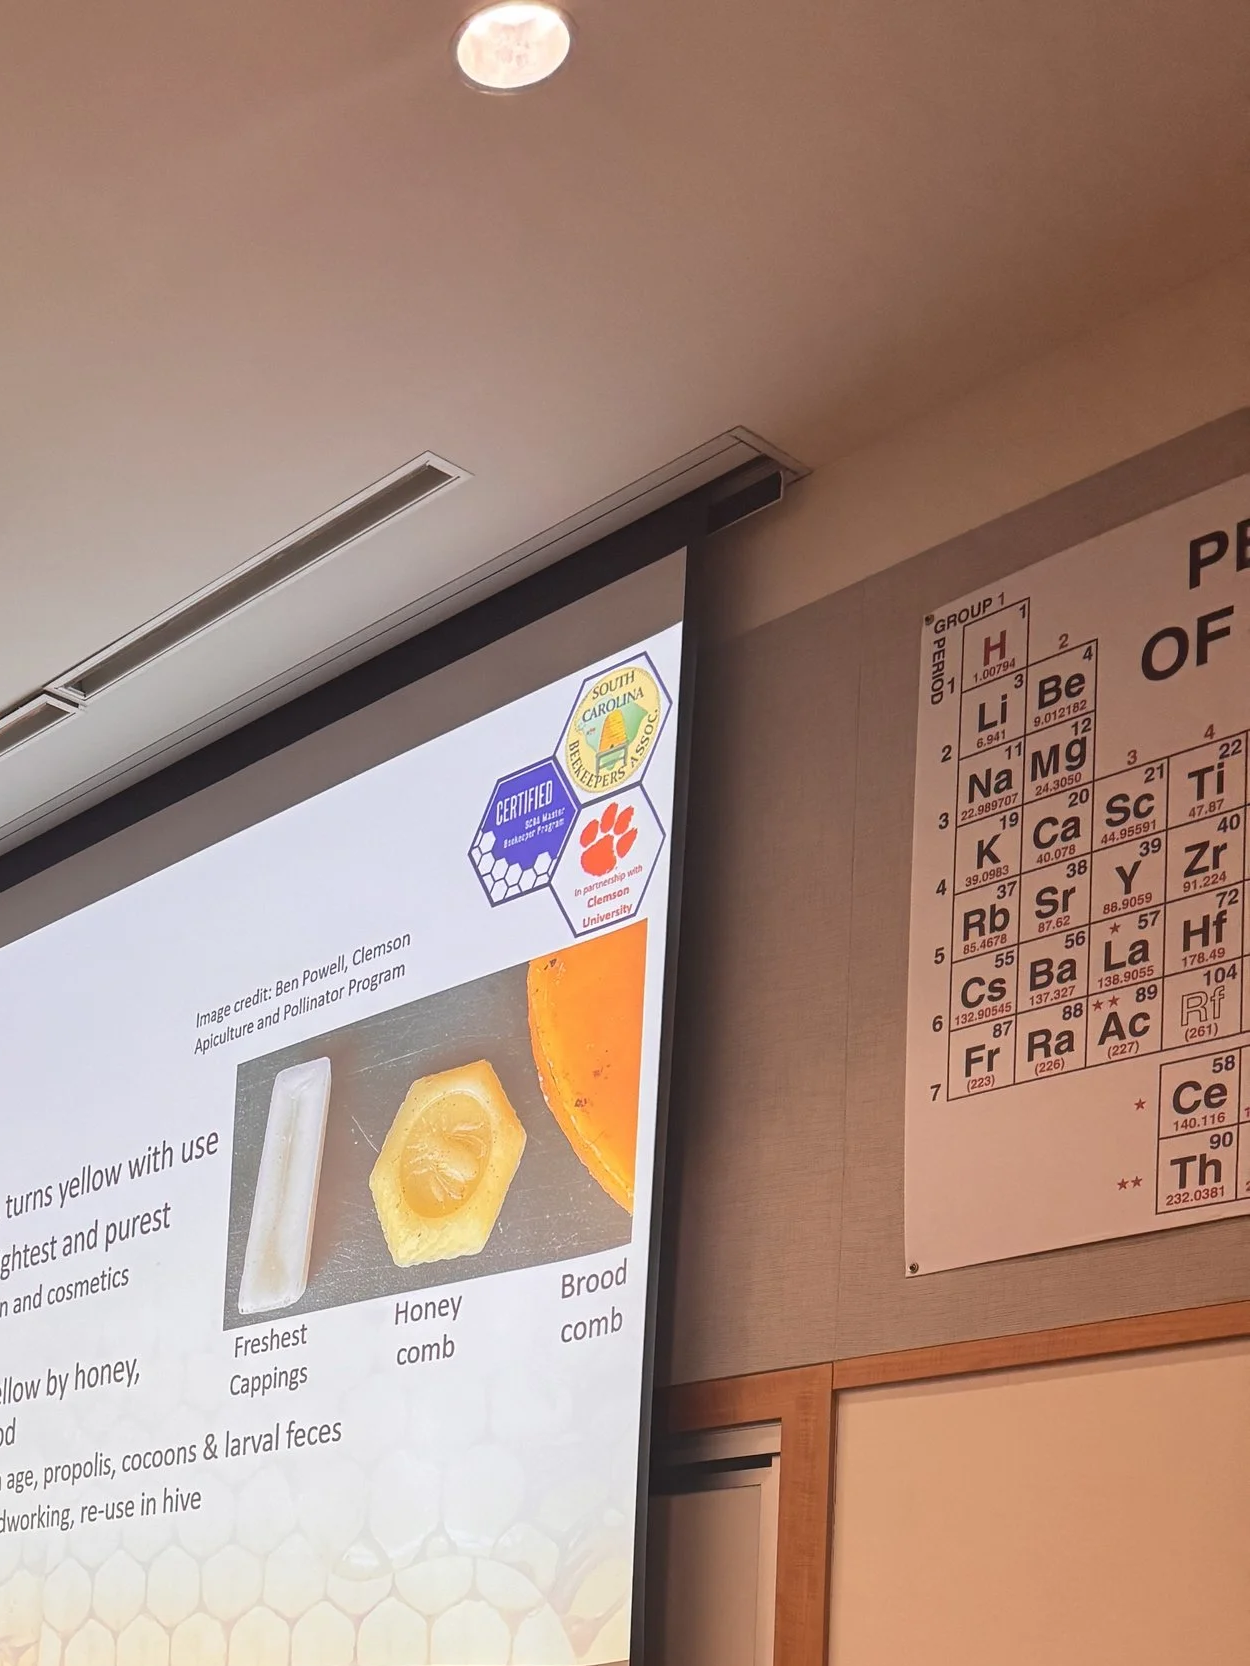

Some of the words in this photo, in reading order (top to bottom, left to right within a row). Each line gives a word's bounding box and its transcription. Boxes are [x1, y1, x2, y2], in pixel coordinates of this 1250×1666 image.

[934, 597, 993, 634] GROUP
[983, 630, 1006, 666] H
[1141, 605, 1234, 681] OF
[592, 670, 635, 700] SOUTH
[931, 636, 945, 705] PERIOD
[973, 658, 1016, 683] 1.00794
[582, 686, 644, 723] CAROLINA
[1038, 672, 1085, 710] Be
[978, 694, 1007, 732] Li
[1034, 700, 1087, 727] 9.012182
[1071, 717, 1092, 736] 12
[568, 740, 626, 789] BEEKEEPERS
[630, 708, 658, 768] ASSOC.
[1031, 736, 1086, 782] Mg
[968, 768, 1013, 804] Na
[1188, 763, 1224, 801] Ti
[496, 780, 553, 826] CERTIFIED
[1106, 792, 1155, 827] Sc
[1032, 815, 1081, 849] Ca
[1101, 819, 1157, 845] 44.95591
[977, 835, 1001, 869] K
[1036, 844, 1076, 864] 40.078
[1184, 841, 1228, 878] Zr
[583, 871, 626, 896] partnership
[627, 864, 642, 880] with
[1115, 861, 1142, 895] Y
[582, 902, 632, 928] University
[587, 886, 630, 909] Clemson
[1034, 884, 1076, 919] Sr
[963, 904, 1010, 941] Rb
[1182, 909, 1228, 952] Hf
[1103, 938, 1150, 972] La
[1182, 947, 1226, 968] 178.49
[196, 1005, 231, 1028] Image
[234, 988, 272, 1013] credit:
[276, 978, 299, 997] Ben
[302, 954, 348, 986] Powell,
[352, 934, 410, 966] Clemson
[1029, 957, 1078, 991] Ba
[1097, 965, 1155, 989] 138.9055
[1203, 964, 1238, 985] 104
[194, 1022, 254, 1055] Apiculture
[257, 1007, 280, 1030] and
[284, 986, 345, 1020] Pollinator
[348, 964, 405, 996] Program
[960, 977, 1006, 1008] Cs
[1180, 986, 1226, 1026] Rf
[955, 1002, 1012, 1026] 132.90545
[1098, 1011, 1150, 1045] Ac
[964, 1044, 1000, 1077] Fr
[1027, 1029, 1075, 1062] Ra
[1034, 1059, 1065, 1076] (226)
[1172, 1080, 1228, 1115] Ce
[1173, 1112, 1226, 1131] 140.116
[6, 1185, 53, 1219] turns
[59, 1163, 122, 1208] yellow
[128, 1140, 173, 1179] with
[182, 1132, 218, 1163] use
[1170, 1154, 1222, 1190] Th
[1166, 1186, 1225, 1206] 232.0381
[62, 1219, 98, 1257] and
[105, 1202, 171, 1252] purest
[13, 1284, 42, 1314] and
[47, 1267, 129, 1305] cosmetics
[562, 1257, 627, 1299] Brood
[395, 1296, 462, 1325] Honey
[561, 1306, 622, 1343] comb
[235, 1324, 308, 1358] Freshest
[397, 1334, 455, 1365] comb
[46, 1368, 69, 1400] by
[75, 1358, 139, 1390] honey,
[230, 1367, 307, 1398] Cappings
[7, 1470, 38, 1493] age,
[43, 1452, 116, 1490] propolis,
[122, 1445, 196, 1472] cocoons
[203, 1433, 218, 1460] &
[225, 1423, 279, 1458] larval
[286, 1420, 341, 1449] feces
[81, 1500, 134, 1523] re-use
[141, 1497, 156, 1516] in
[163, 1487, 201, 1513] hive
